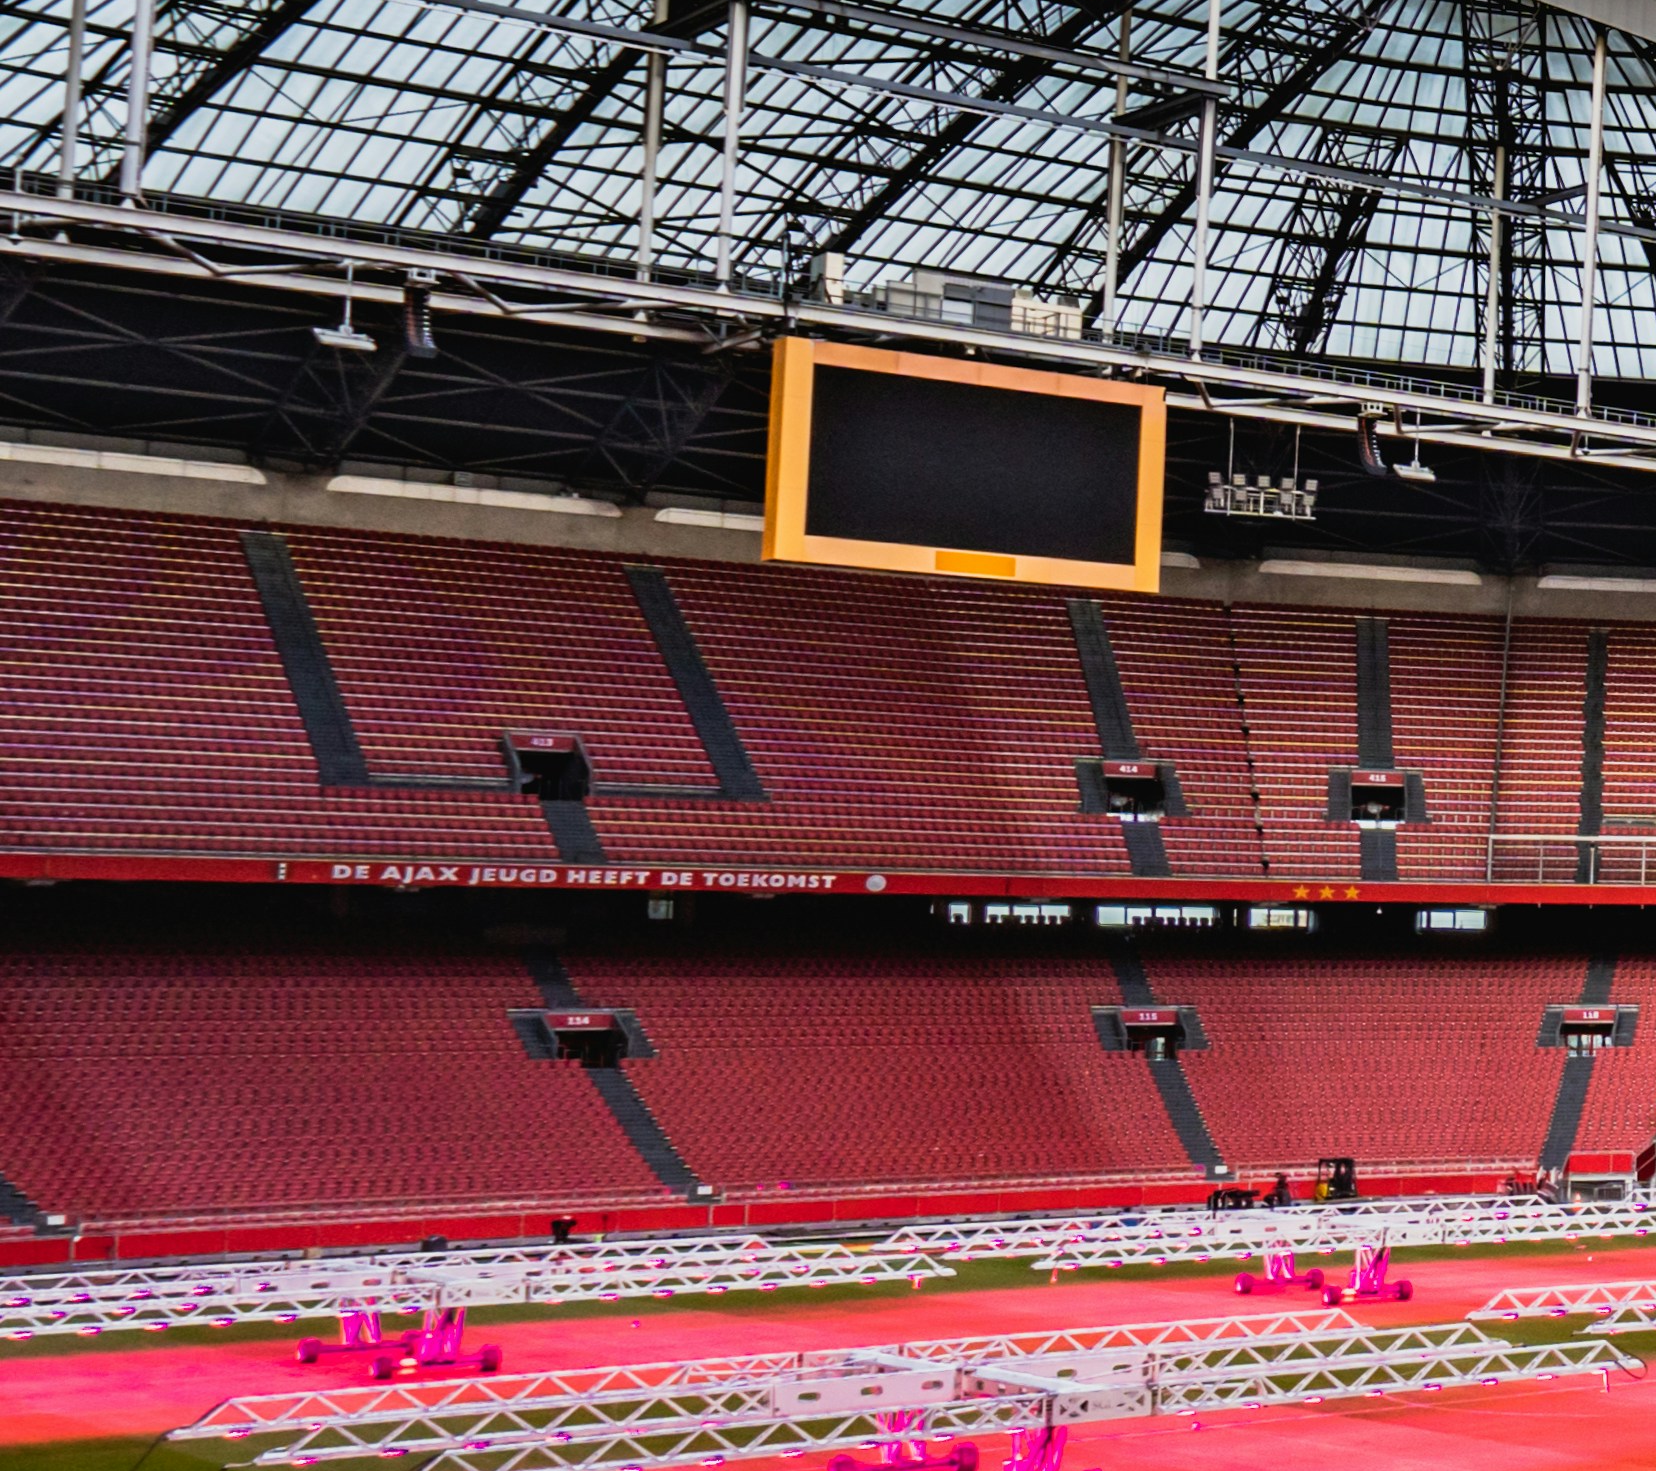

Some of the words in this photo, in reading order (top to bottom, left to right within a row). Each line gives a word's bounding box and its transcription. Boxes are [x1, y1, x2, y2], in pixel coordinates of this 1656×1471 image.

[1119, 765, 1137, 773] 414
[332, 864, 371, 879] DE
[380, 866, 459, 884] AJAX
[468, 867, 557, 885] JEUGD
[566, 870, 650, 885] HEEFT
[661, 871, 693, 886] DE
[702, 872, 837, 889] TOEKOMST
